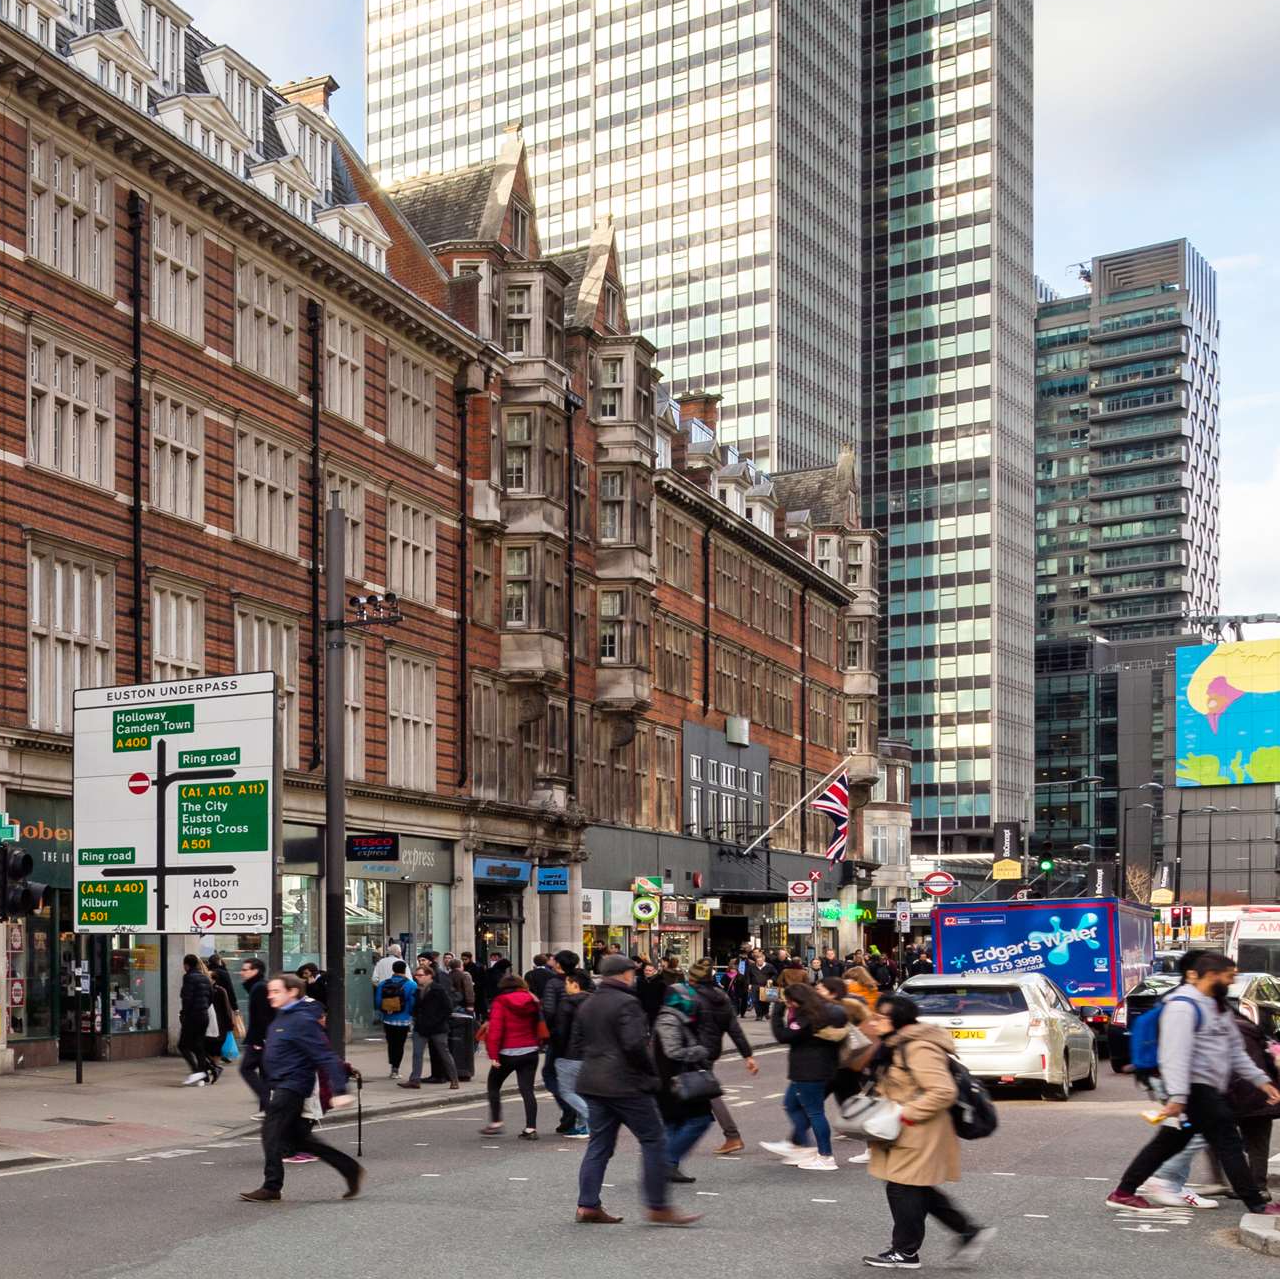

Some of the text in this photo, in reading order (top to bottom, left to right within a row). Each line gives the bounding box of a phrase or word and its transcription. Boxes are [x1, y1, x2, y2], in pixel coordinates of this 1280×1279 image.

[107, 680, 238, 701] EUSTON UNDERPASS
[117, 712, 166, 723] Holloway
[116, 720, 191, 734] Camden Town
[183, 751, 236, 765] Ring road
[181, 801, 228, 812] The City
[182, 813, 221, 824] Euston
[182, 824, 249, 836] Kings Cross
[353, 837, 393, 847] TESCO
[1003, 829, 1012, 857] BoConcept
[42, 851, 58, 863] THE
[81, 850, 132, 863] Ring road
[357, 849, 388, 857] express
[401, 848, 435, 872] express
[193, 878, 239, 888] Holborn
[1096, 869, 1104, 894] BoConcept
[81, 898, 118, 908] Kilburn
[247, 912, 263, 924] yds
[972, 926, 1097, 964] Edgar's Water
[991, 961, 1013, 973] 579
[1015, 955, 1043, 967] 3999
